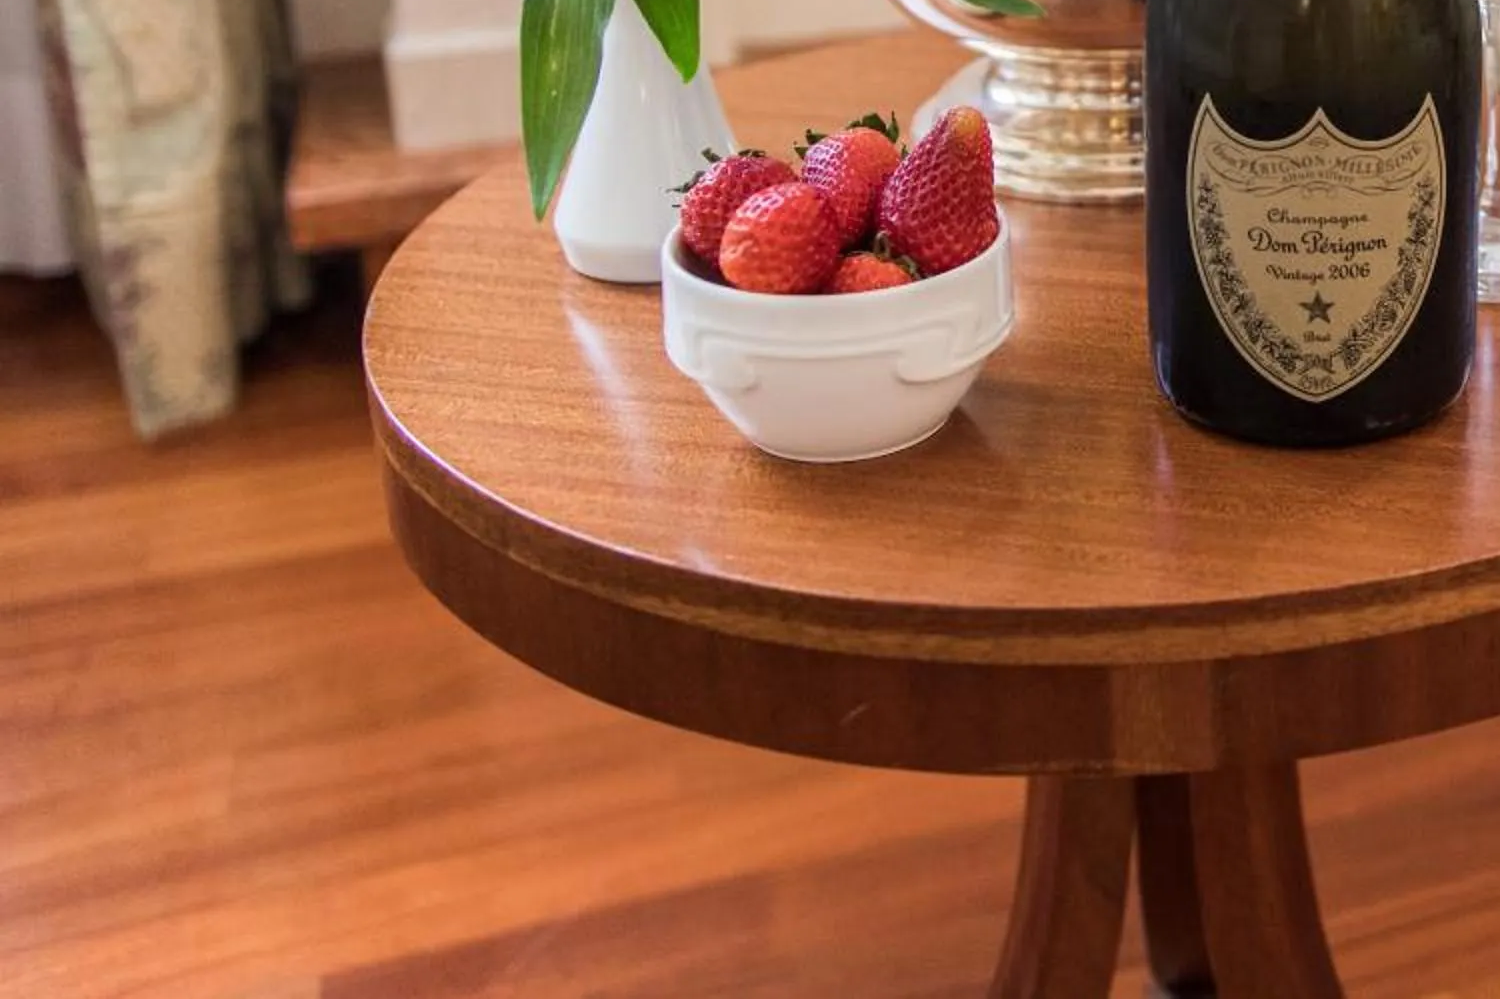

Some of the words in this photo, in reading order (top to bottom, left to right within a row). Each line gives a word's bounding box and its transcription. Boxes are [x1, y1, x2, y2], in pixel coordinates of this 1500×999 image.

[1266, 207, 1369, 230] Champagne
[1247, 226, 1299, 254] Dom
[1300, 230, 1388, 261] Pérignon
[1265, 264, 1325, 286] Vintage
[1328, 262, 1372, 280] 2006
